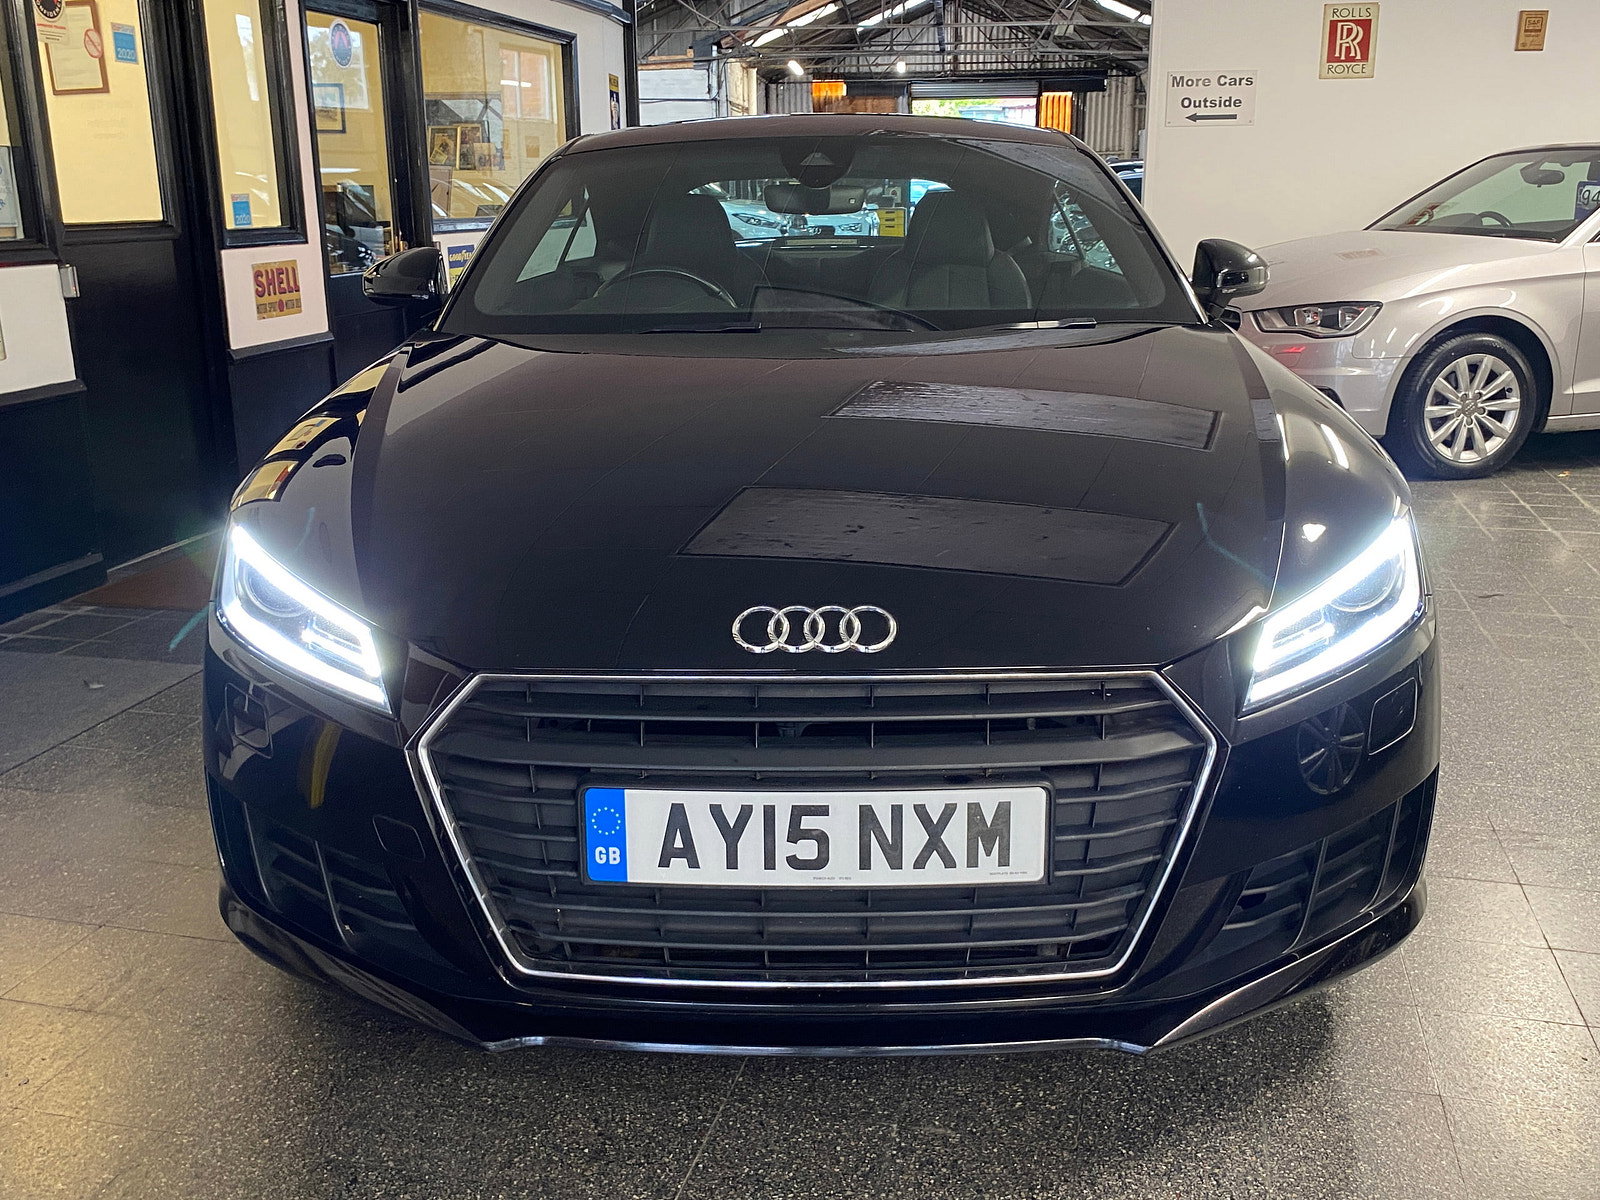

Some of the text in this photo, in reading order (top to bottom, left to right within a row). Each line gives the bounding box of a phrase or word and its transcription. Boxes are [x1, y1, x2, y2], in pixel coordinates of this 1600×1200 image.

[1332, 7, 1372, 18] ROLLS
[117, 47, 136, 59] 2020
[1327, 64, 1367, 75] ROYCE
[1171, 74, 1254, 88] More Cars
[1180, 96, 1243, 109] Outside
[254, 266, 300, 298] SHELL
[657, 801, 1012, 871] AY15 NXM
[594, 846, 621, 866] GB
